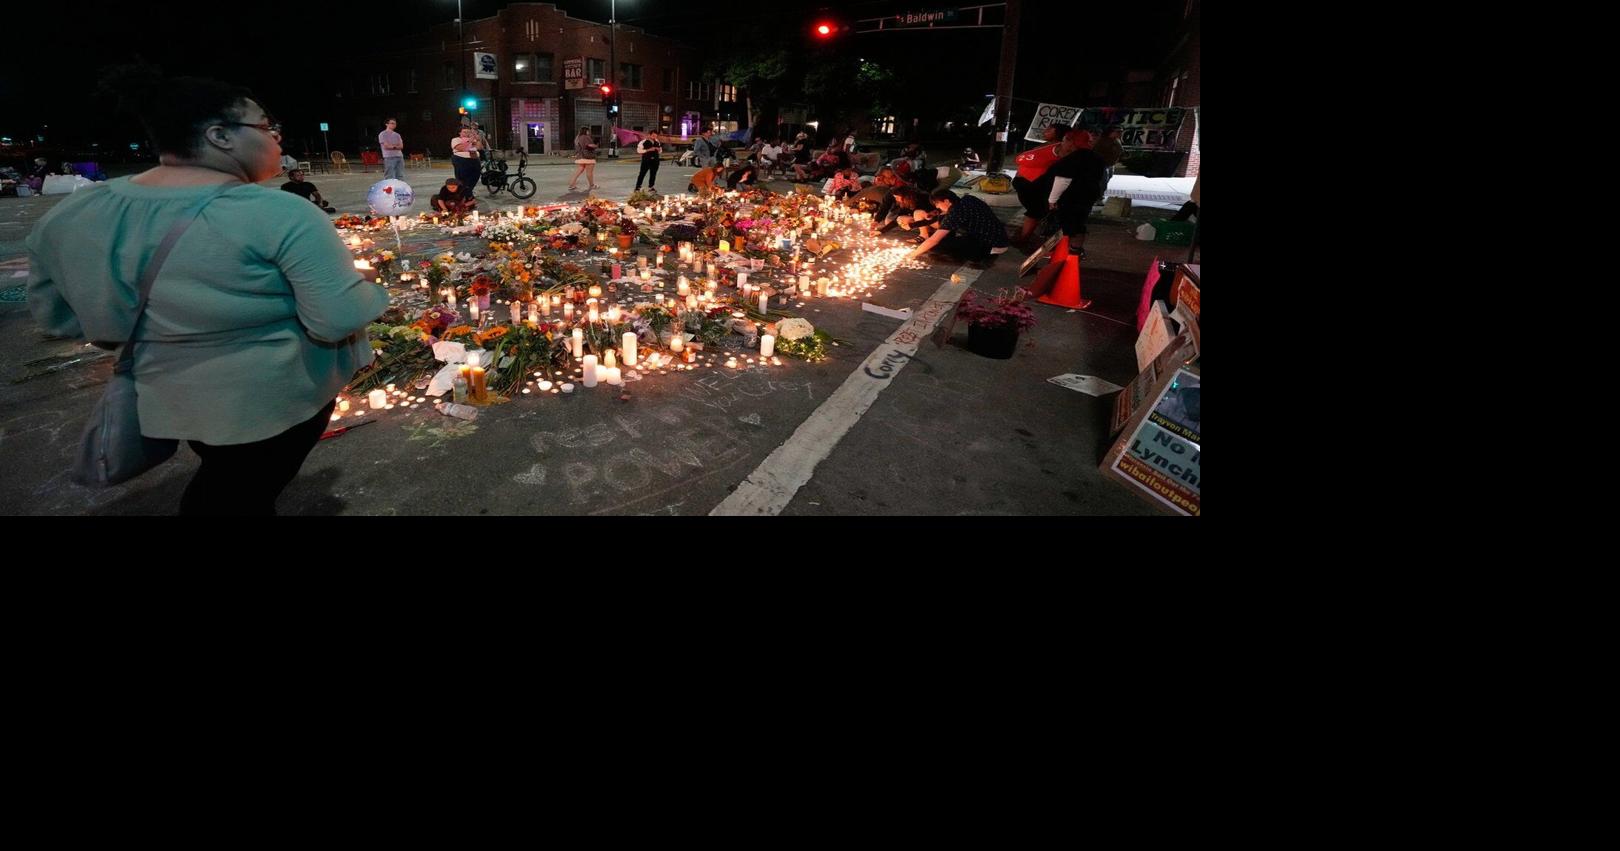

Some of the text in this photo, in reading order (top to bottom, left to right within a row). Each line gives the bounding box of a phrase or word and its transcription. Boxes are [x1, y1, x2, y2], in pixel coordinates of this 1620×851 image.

[906, 11, 944, 24] Baldwin
[565, 68, 582, 78] BAR
[1039, 105, 1079, 120] COREY
[1151, 411, 1181, 434] Trayvon
[1153, 430, 1185, 455] No
[1130, 439, 1200, 489] Lynch
